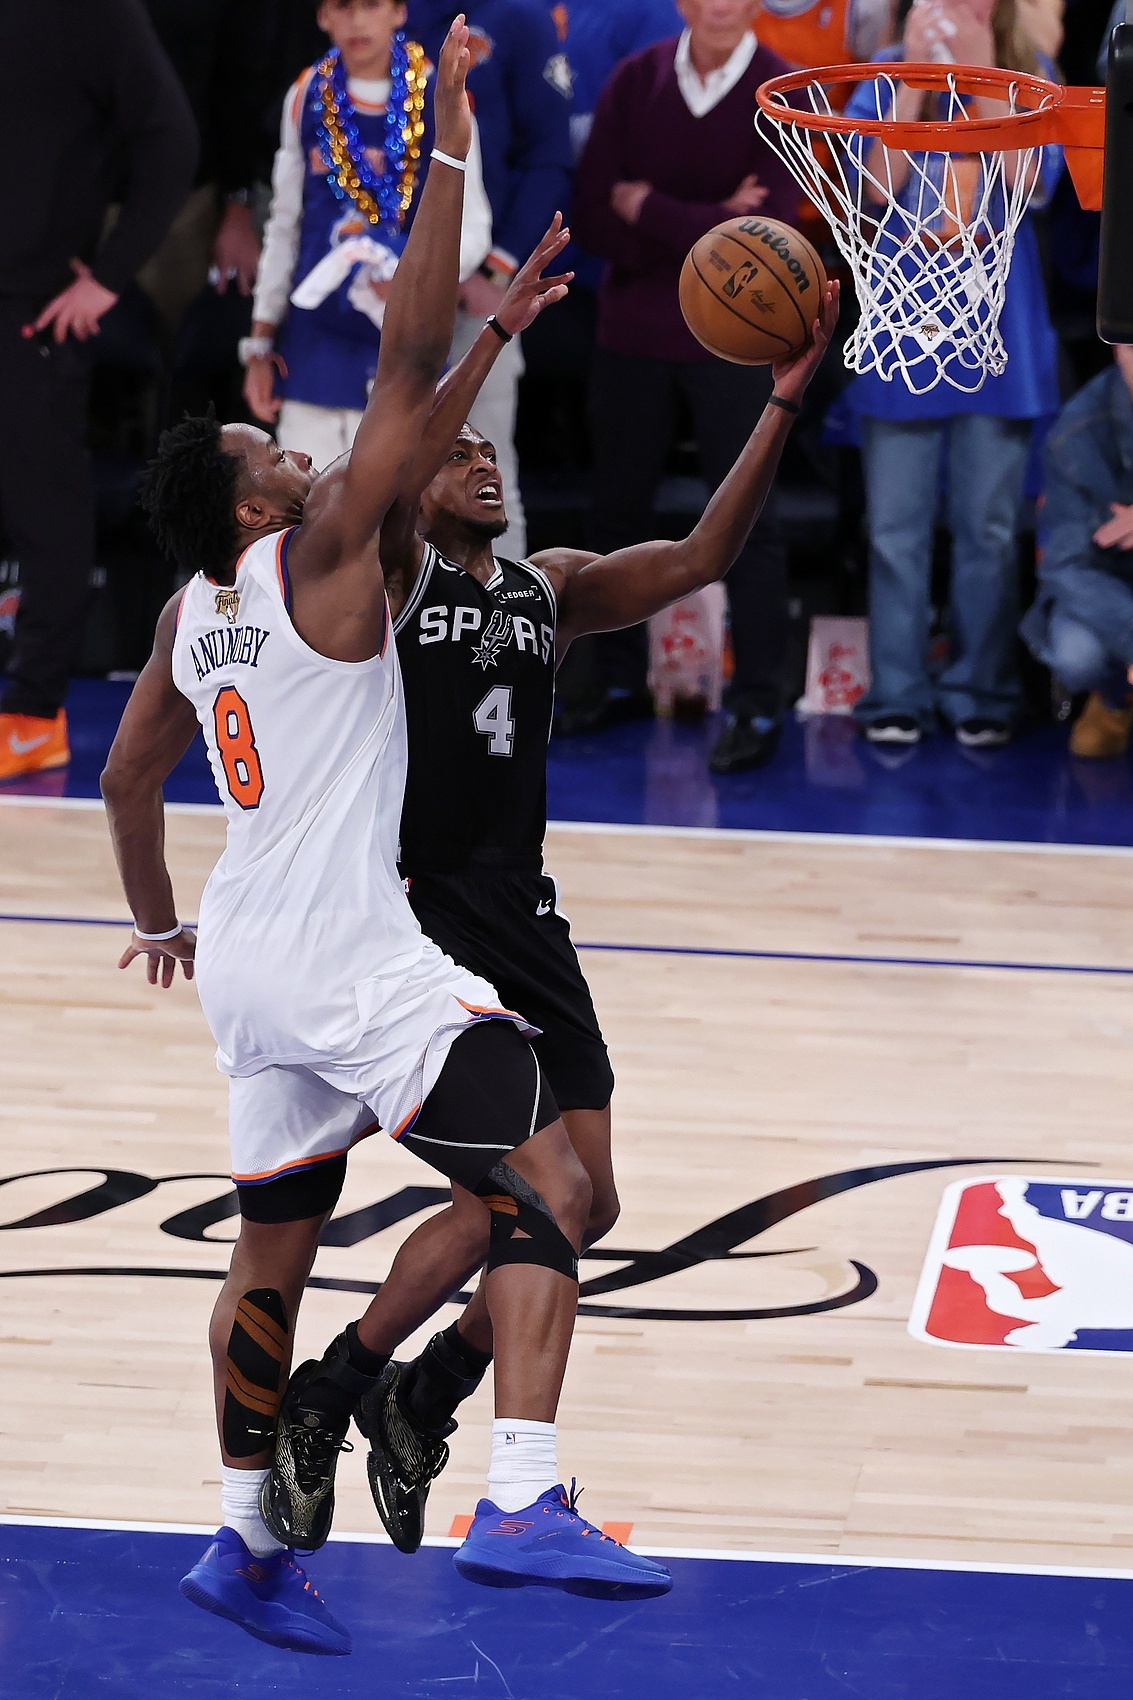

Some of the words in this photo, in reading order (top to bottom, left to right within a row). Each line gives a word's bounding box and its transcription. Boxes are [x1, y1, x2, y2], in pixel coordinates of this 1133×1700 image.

[738, 219, 810, 294] Wilson
[501, 589, 535, 600] LEDGER
[418, 604, 554, 669] SPURS
[212, 684, 265, 811] 8
[472, 684, 516, 758] 4
